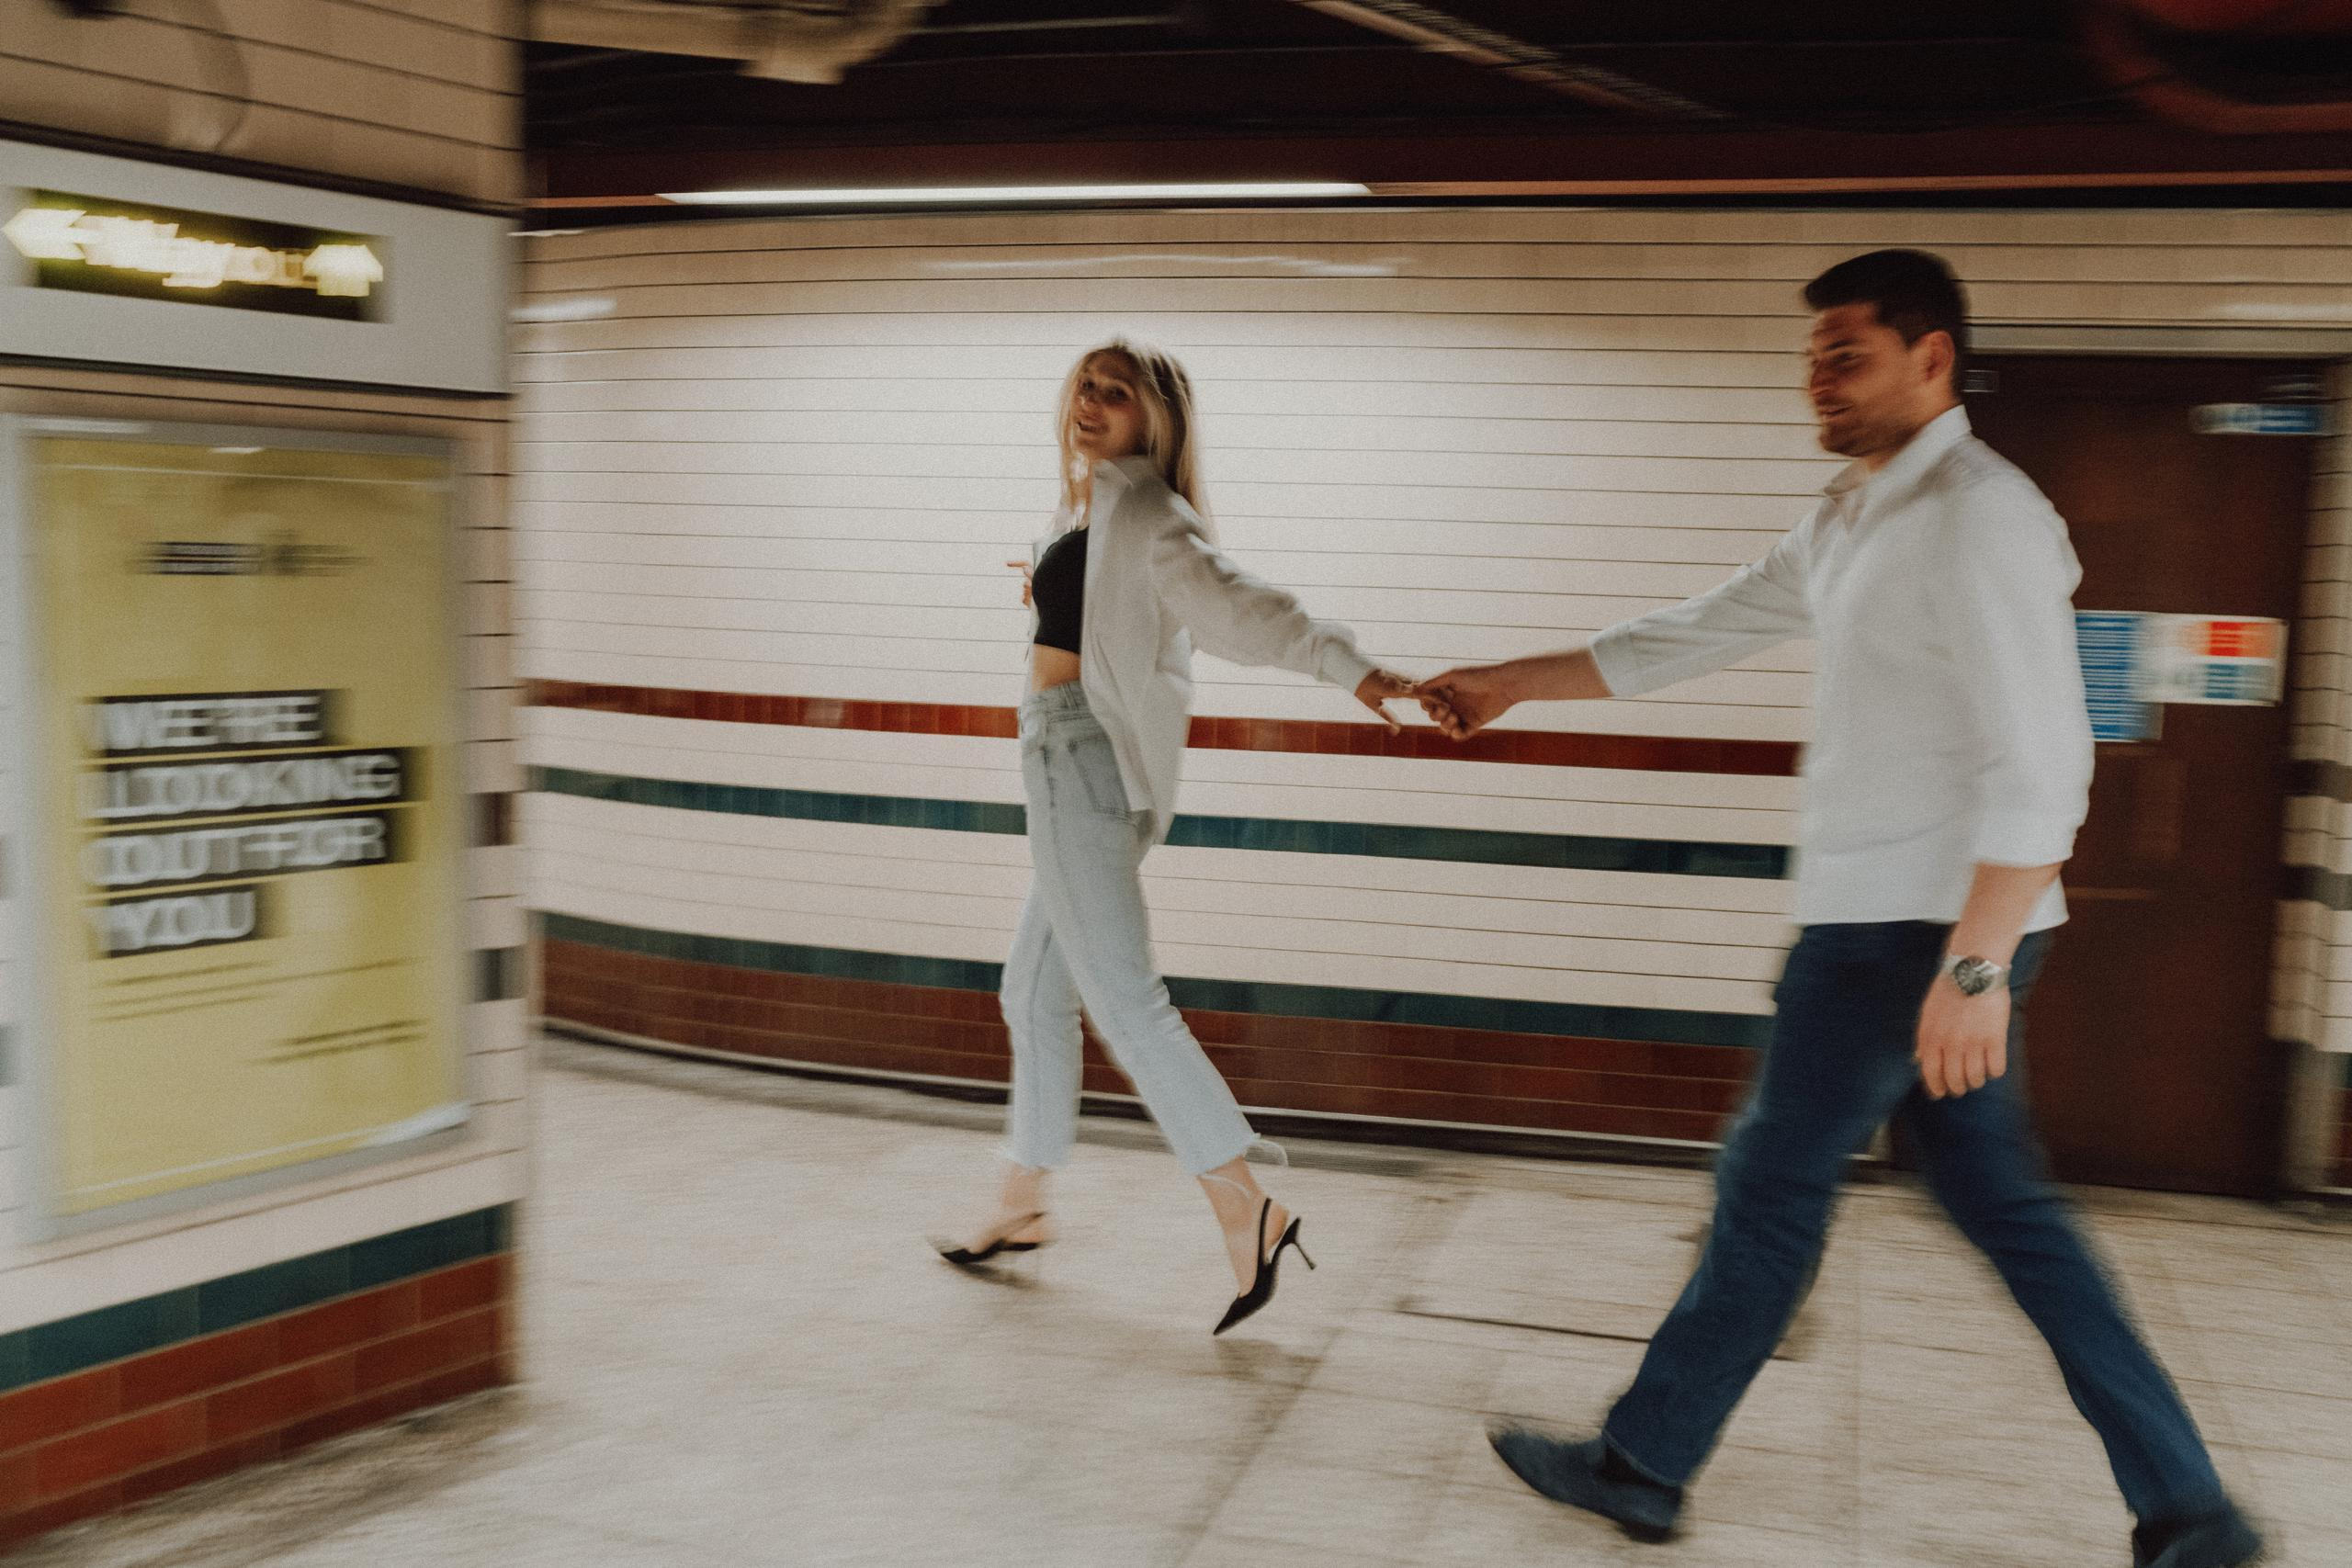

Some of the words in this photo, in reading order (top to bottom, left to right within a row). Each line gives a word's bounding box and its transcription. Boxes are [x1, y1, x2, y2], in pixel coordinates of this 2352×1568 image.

[86, 754, 401, 819] LOOKING
[86, 827, 259, 886] OUT
[88, 891, 256, 952] YOU
